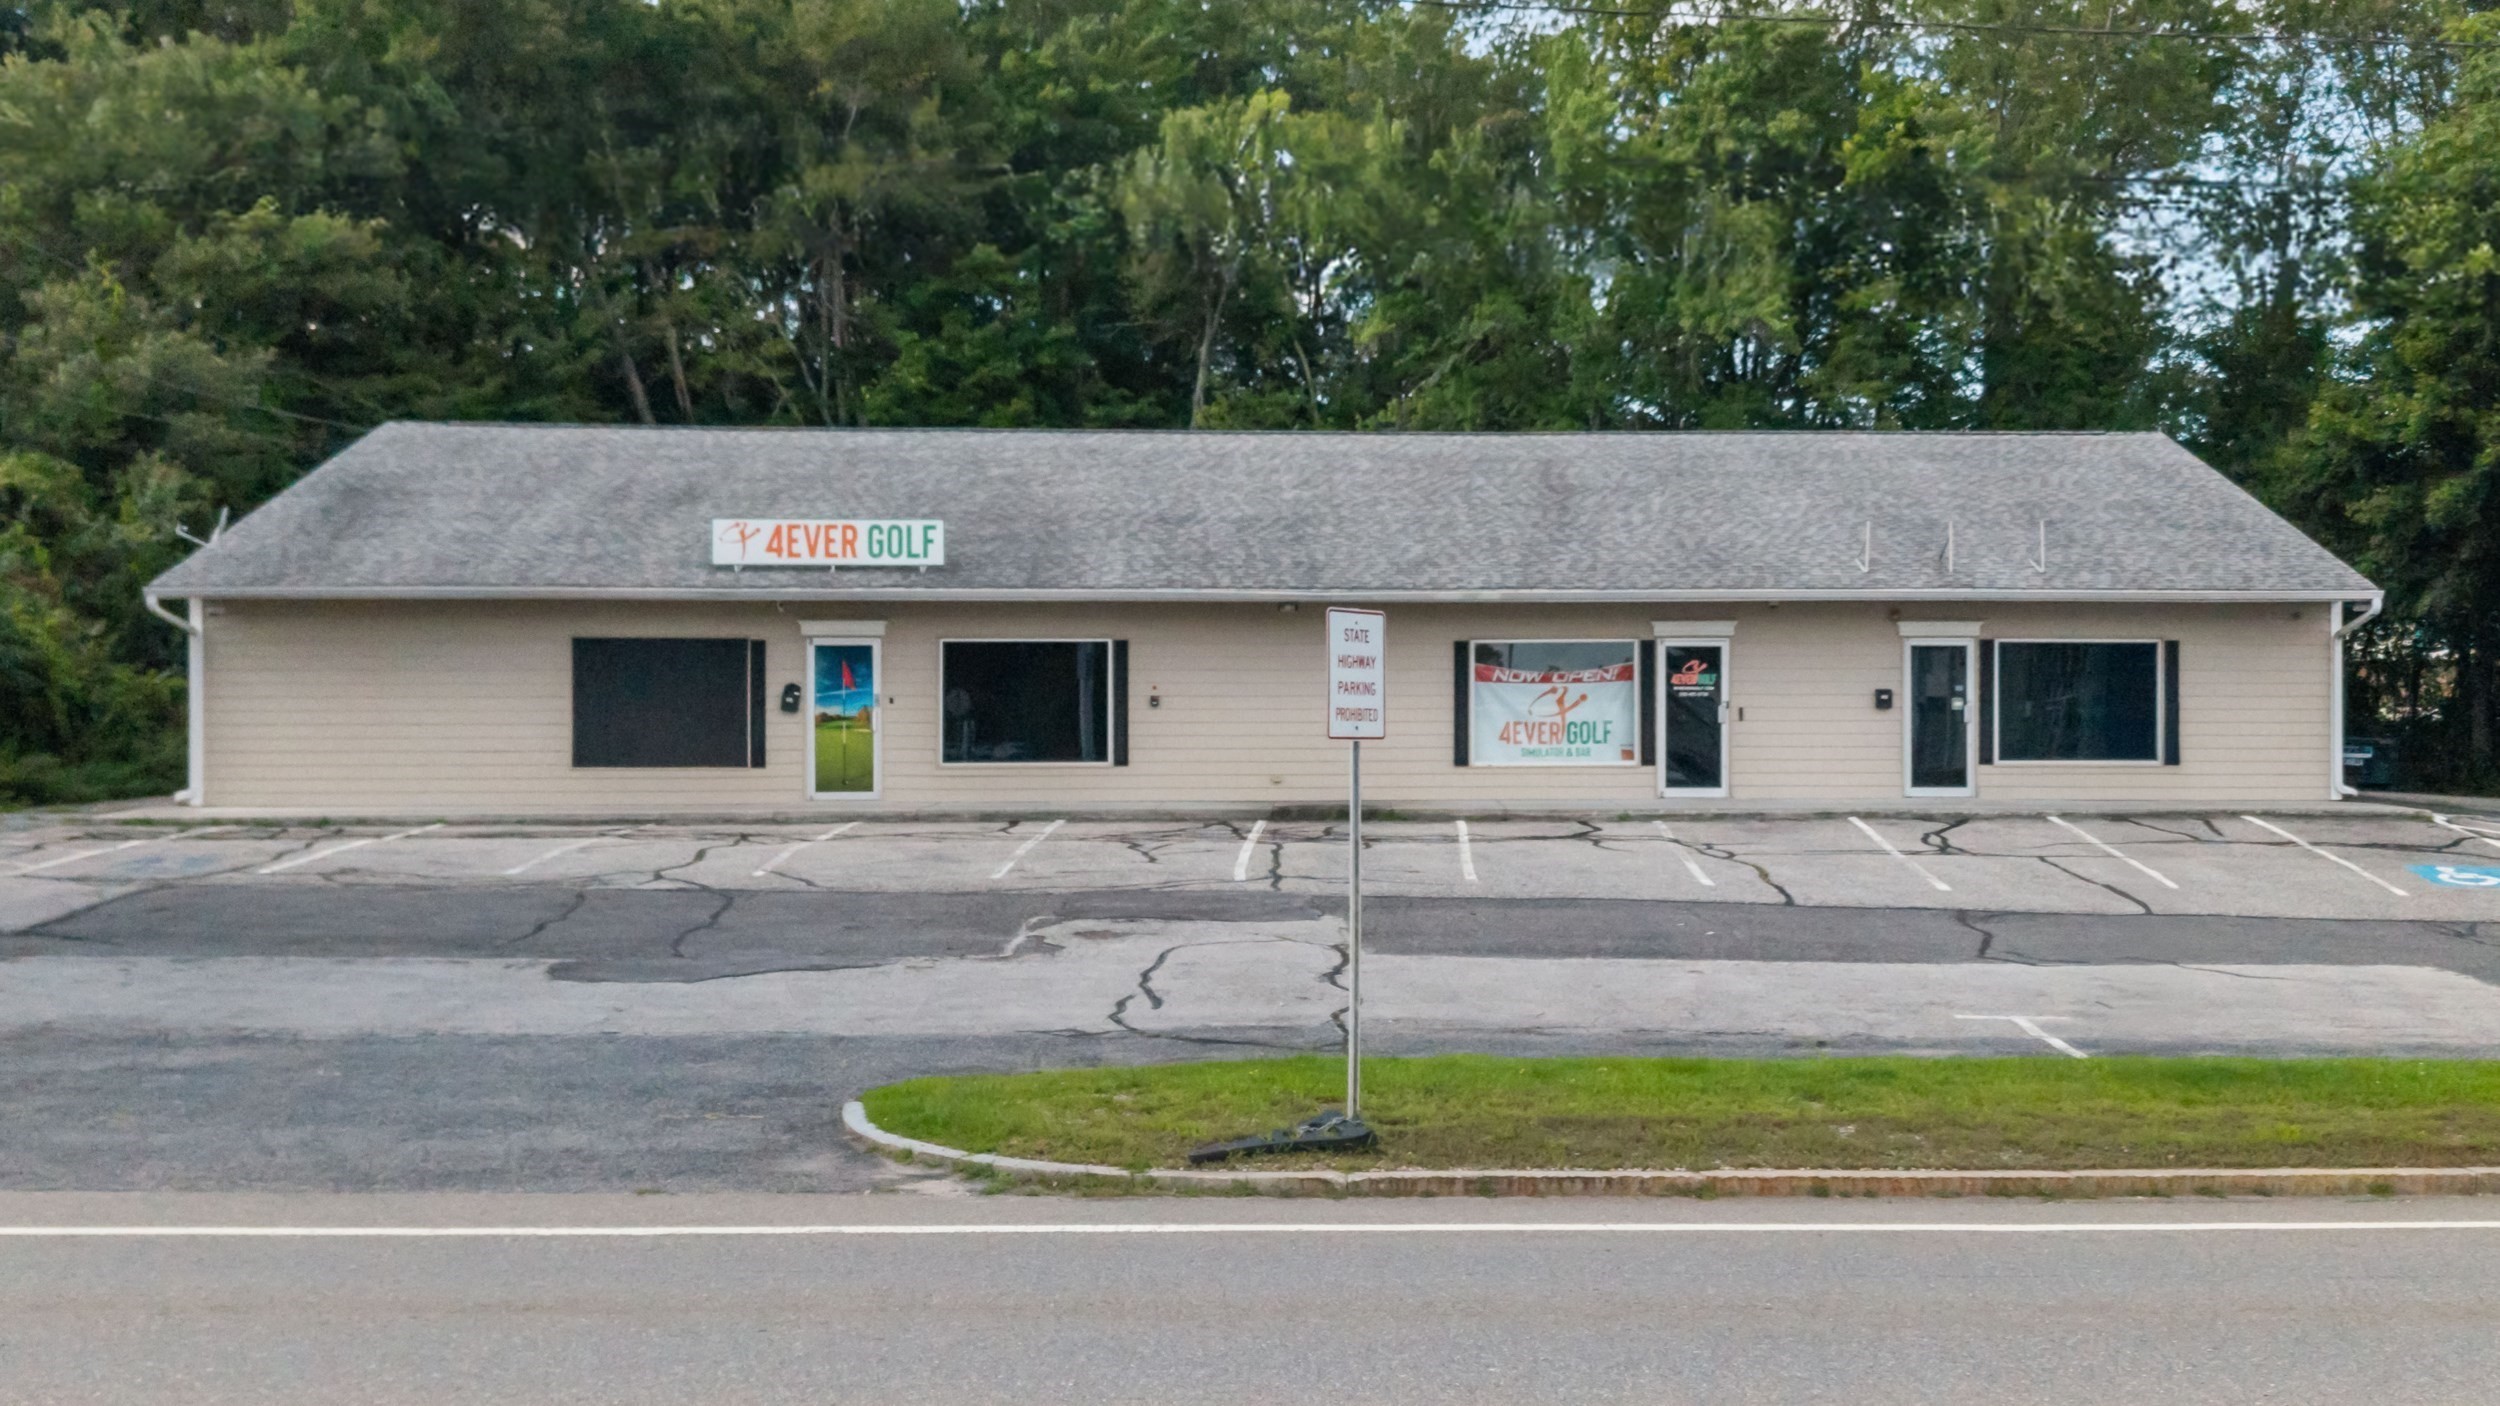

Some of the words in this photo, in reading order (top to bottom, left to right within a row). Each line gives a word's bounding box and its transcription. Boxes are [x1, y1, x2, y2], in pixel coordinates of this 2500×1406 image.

[765, 524, 858, 558] 4EVER
[867, 524, 937, 558] GOLF
[1344, 628, 1370, 643] STATE
[1338, 655, 1376, 668] HIGHWAY
[1492, 669, 1543, 682] NOW
[1552, 668, 1619, 682] OPEN!
[1338, 681, 1376, 695] PARKING
[1336, 708, 1378, 722] PROHIBITED
[1499, 721, 1561, 745] 4EVER
[1566, 720, 1613, 744] GOLF
